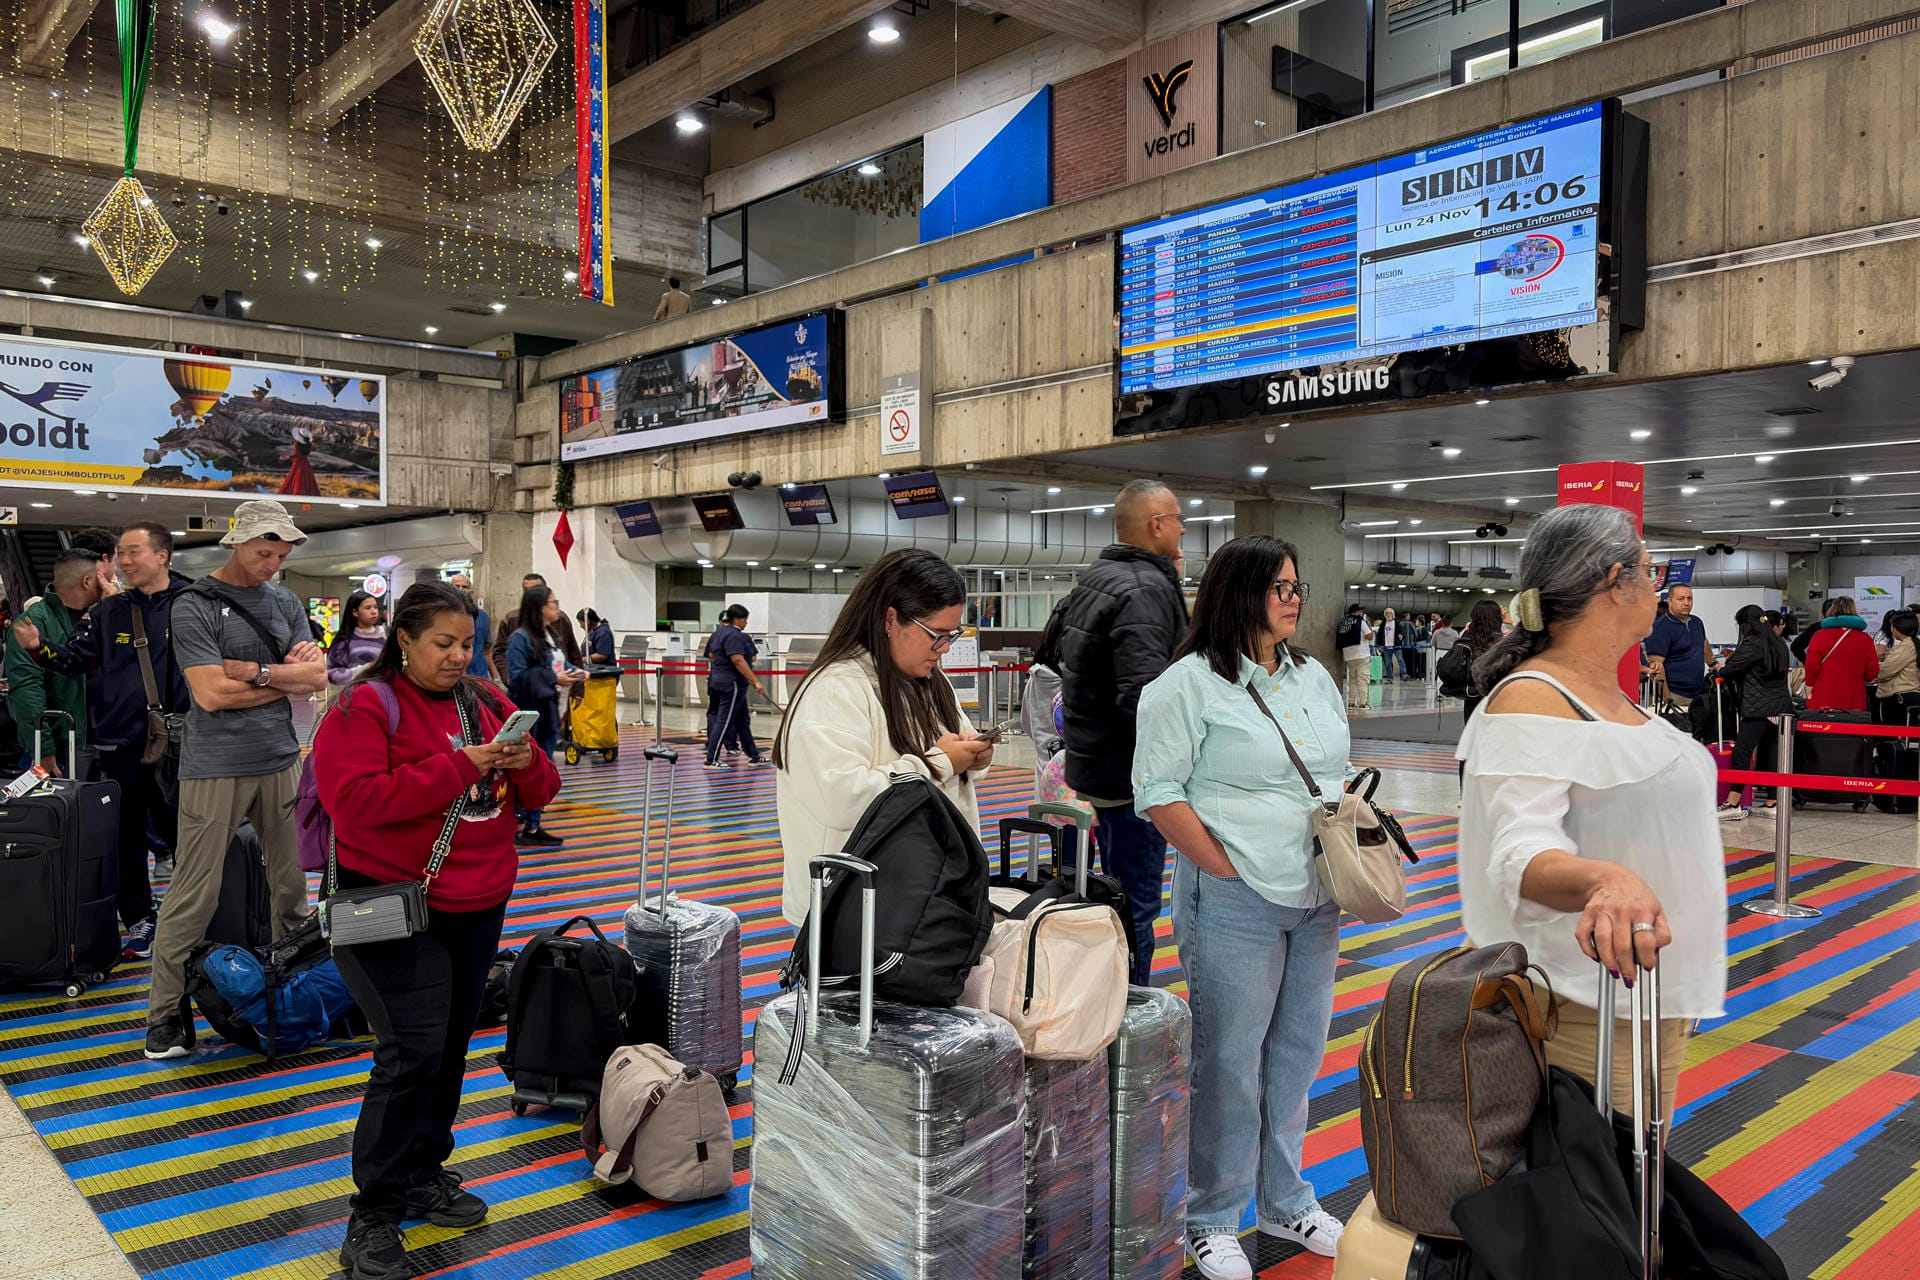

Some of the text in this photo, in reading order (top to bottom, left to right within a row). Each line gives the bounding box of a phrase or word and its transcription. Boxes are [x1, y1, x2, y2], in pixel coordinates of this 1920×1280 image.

[1428, 105, 1593, 155] AEROPUERTO INTERNACIONAL DE MAIQUETÍA
[1145, 122, 1195, 158] verdi
[1401, 201, 1428, 213] Sistema
[1441, 188, 1483, 204] Información
[1486, 185, 1495, 193] de
[1498, 179, 1522, 191] Vuelos
[1524, 174, 1542, 184] IAIM
[1474, 173, 1586, 220] 14:06
[1203, 212, 1250, 228] PROCEDENCIA
[1207, 226, 1236, 238] PANAMA
[1301, 204, 1323, 215] SALIO
[1385, 206, 1469, 233] Lun 24 Nov
[1473, 205, 1592, 238] Cartelera Informativa
[1163, 229, 1184, 238] VUELO
[1208, 241, 1242, 255] ESTAMBUL
[1301, 216, 1348, 233] CANCELADO
[1208, 234, 1240, 246] CURAZAO
[1207, 260, 1235, 271] BOGOTA
[1301, 235, 1348, 250] CANCELADO
[1217, 249, 1246, 261] HABANA
[1207, 277, 1234, 288] MADRID
[1301, 253, 1347, 268] CANCELADO
[1207, 269, 1236, 280] PANAMA
[1376, 267, 1402, 280] MISIÓN
[1207, 284, 1239, 296] CURAZAO
[1207, 302, 1234, 313] MADRID
[1300, 280, 1347, 294] CANCELADO
[1509, 282, 1540, 296] VISIÓN
[1207, 294, 1234, 305] BOGOTA
[1207, 311, 1234, 321] MADRID
[1300, 289, 1347, 303] CANCELADO
[1207, 320, 1235, 330] CANCUN
[1206, 335, 1238, 346] CURAZAO
[1207, 346, 1228, 354] SANTA
[1229, 342, 1249, 350] LUCIA
[1250, 337, 1278, 347] MEXICO
[1200, 368, 1238, 380] usuarios
[1240, 366, 1257, 376] que
[1288, 357, 1309, 367] sitio
[1312, 352, 1339, 363] 100%
[1342, 347, 1369, 359] libre
[1370, 345, 1384, 354] de
[1386, 339, 1419, 352] humo
[1420, 337, 1435, 347] de
[1437, 331, 1476, 344] tabaco
[1491, 324, 1516, 336] The
[1519, 317, 1563, 334] airport
[1206, 352, 1238, 363] CURAZAO
[59, 360, 93, 373] CON
[1206, 361, 1234, 371] PANAMA
[1268, 366, 1389, 405] SAMSUNG
[13, 467, 125, 480] @VIAJESHUMBOLDTPLUS
[1564, 481, 1593, 489] IBERIA
[1616, 480, 1634, 488] IBERIA
